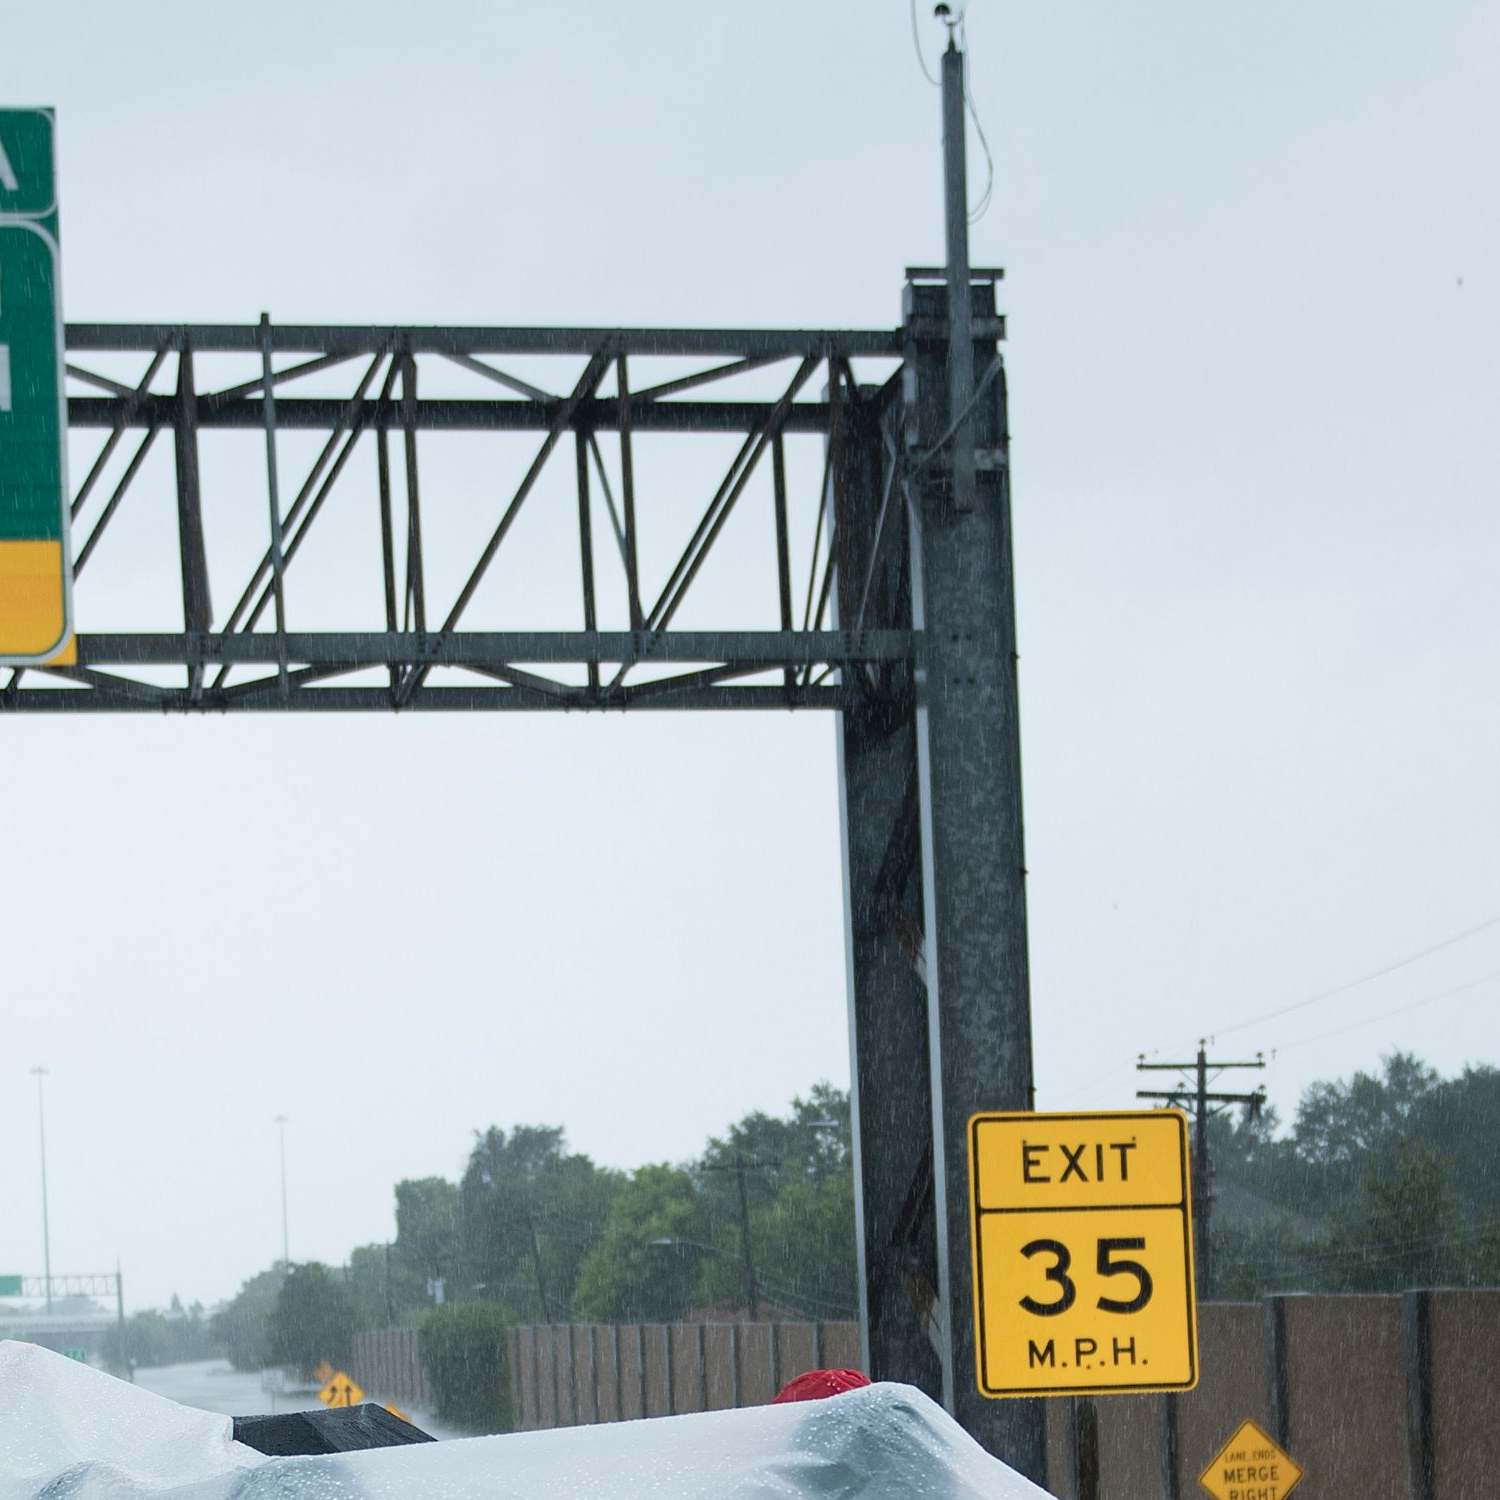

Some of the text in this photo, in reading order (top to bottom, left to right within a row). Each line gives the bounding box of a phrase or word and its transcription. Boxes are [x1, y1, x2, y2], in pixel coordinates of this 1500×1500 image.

[1022, 1141, 1137, 1184] EXIT
[1017, 1237, 1154, 1317] 35
[1027, 1336, 1149, 1369] M.P.H.
[1223, 1465, 1279, 1484] MERGE
